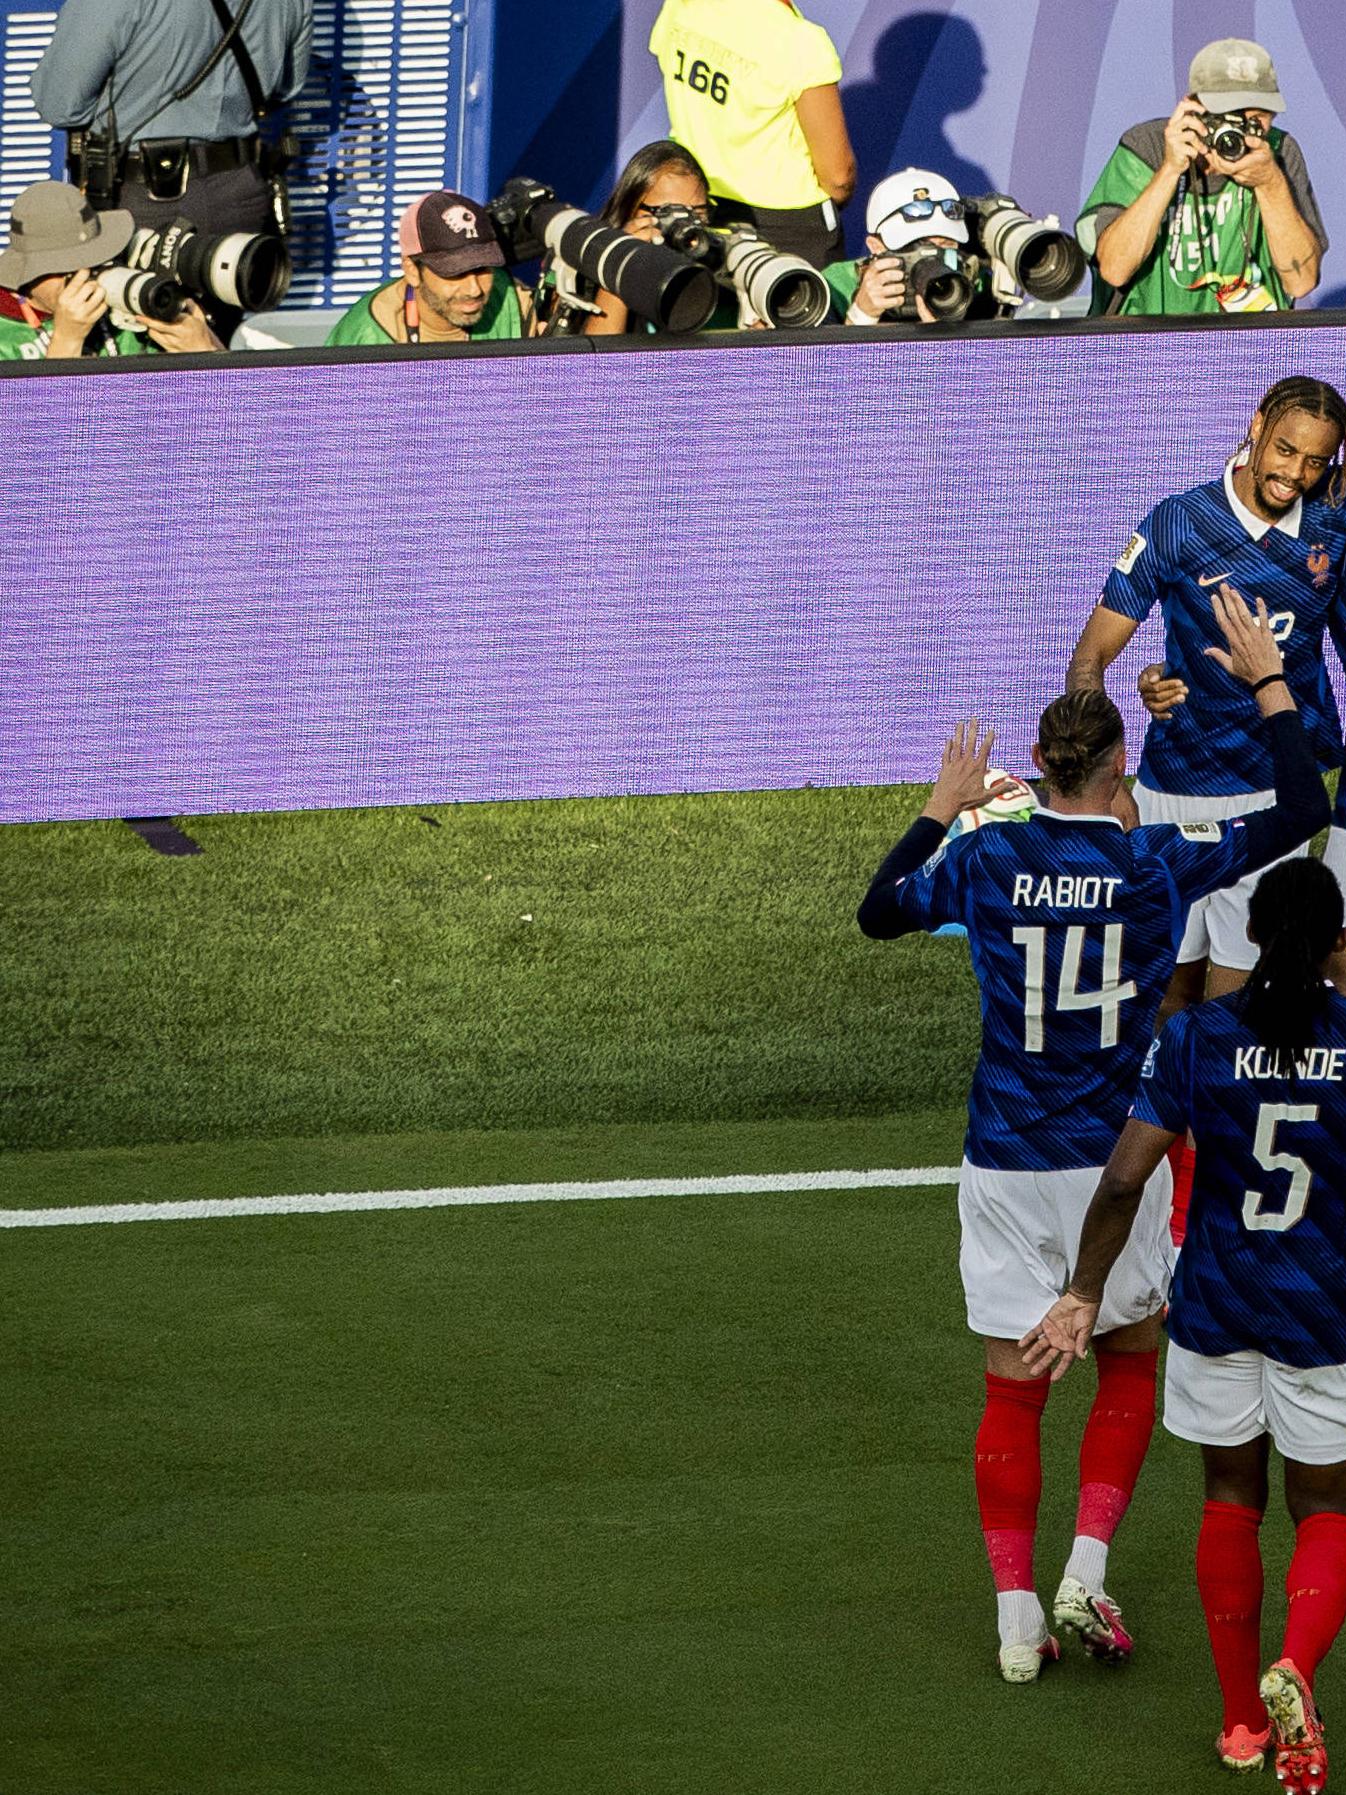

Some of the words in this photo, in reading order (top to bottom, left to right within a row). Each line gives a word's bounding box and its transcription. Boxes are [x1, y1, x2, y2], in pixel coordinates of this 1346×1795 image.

[674, 49, 729, 105] 166
[1012, 874, 1123, 909] RABIOT
[1012, 923, 1138, 1052] 14
[1242, 1103, 1319, 1232] 5
